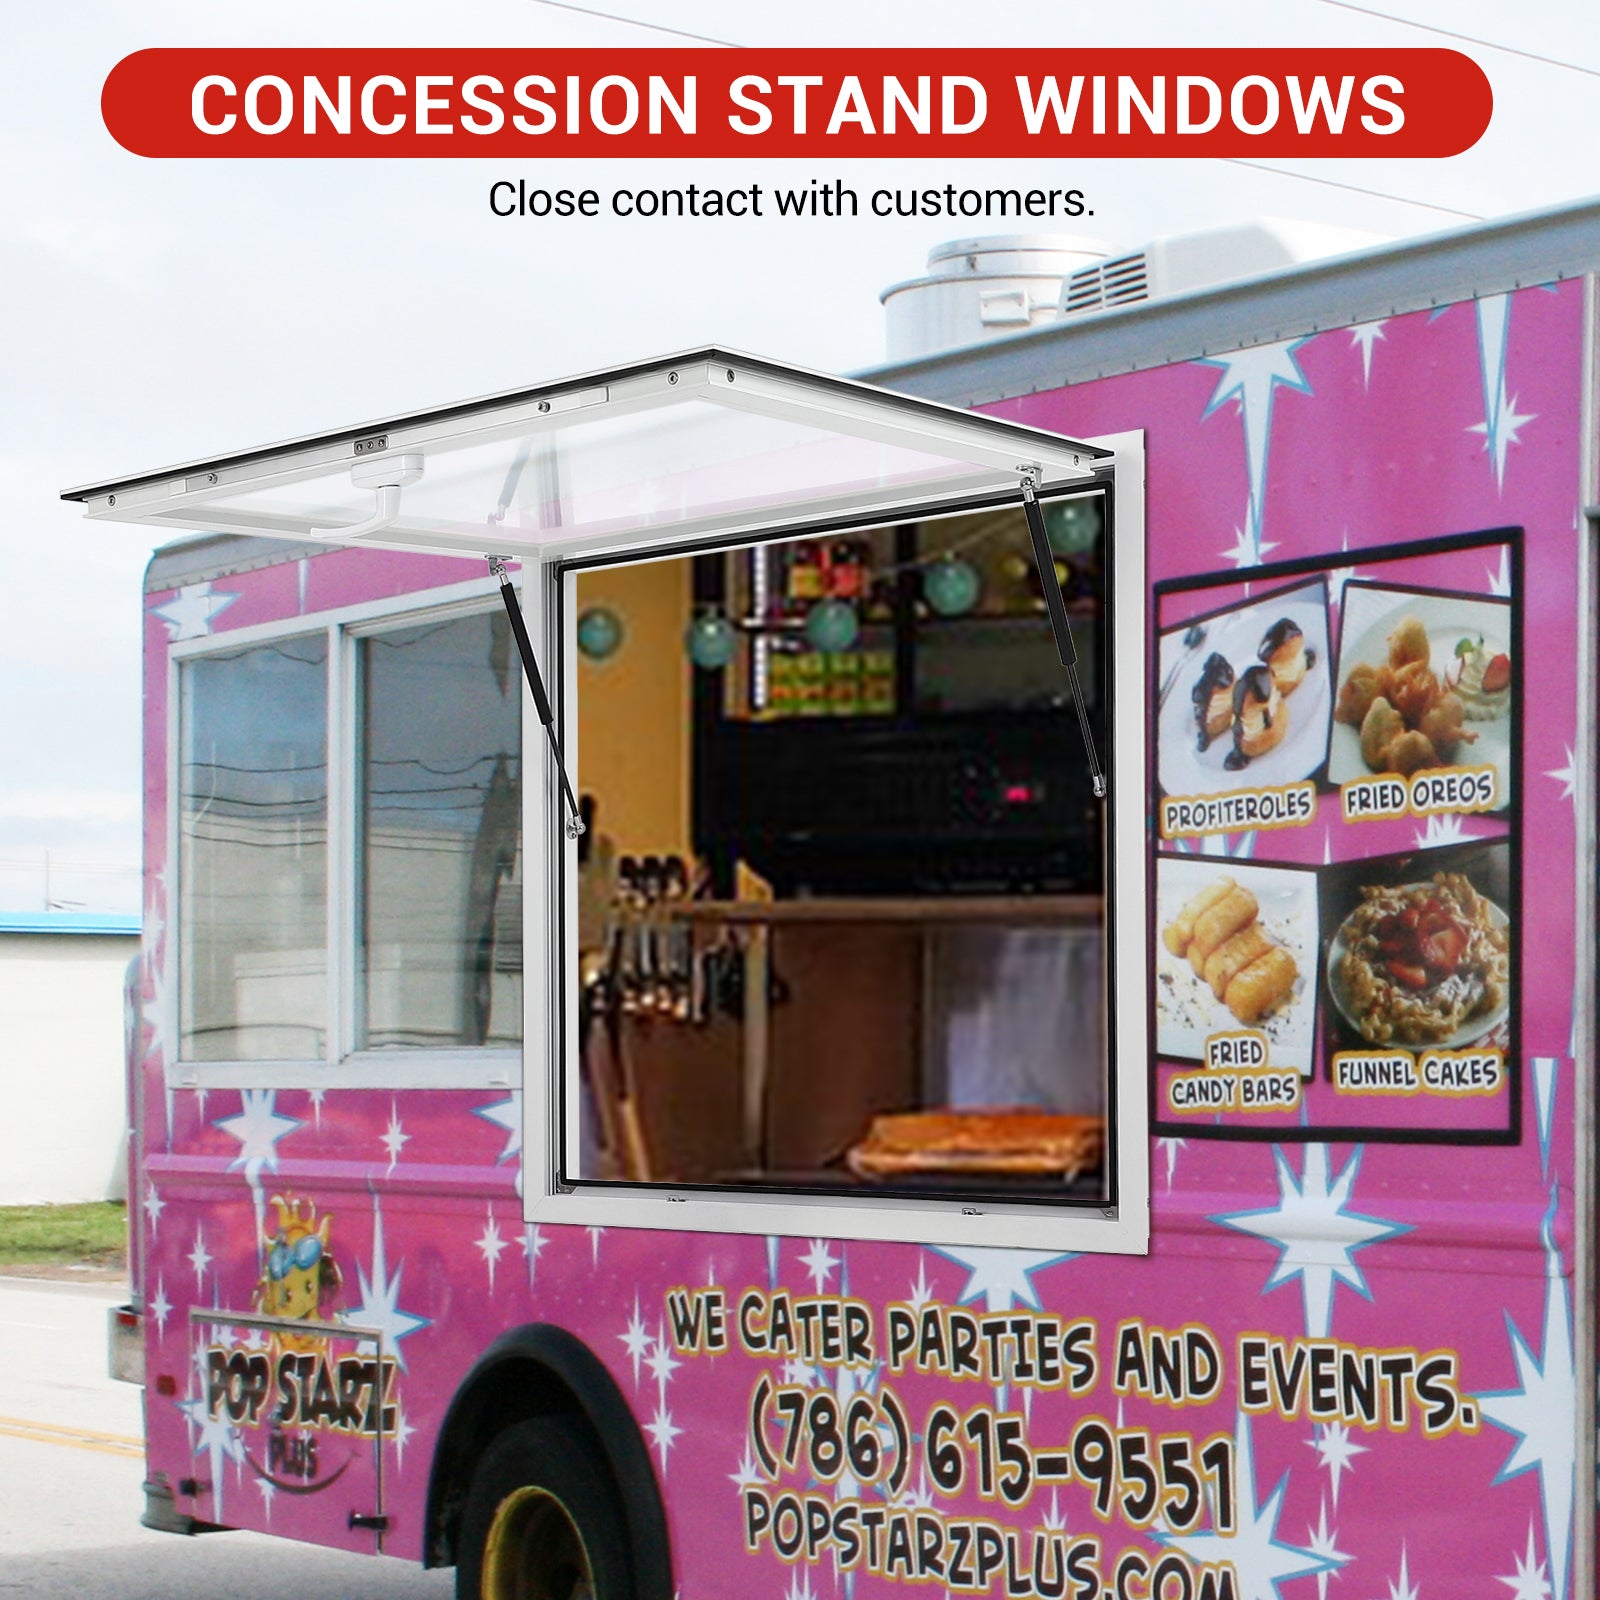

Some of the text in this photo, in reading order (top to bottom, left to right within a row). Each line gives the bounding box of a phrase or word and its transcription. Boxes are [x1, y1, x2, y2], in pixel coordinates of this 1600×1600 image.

[1166, 788, 1312, 830] PROFITEROLES
[1347, 773, 1493, 815] FRIED OREOS
[1210, 1040, 1263, 1065] FRIED
[1338, 1058, 1499, 1087] FUNNEL CAKES
[1171, 1076, 1297, 1105] CANDY BARS
[668, 1291, 1479, 1430] WE CATER PARTIES AND EVENTS.
[207, 1349, 398, 1434] POP STARZ
[268, 1433, 317, 1478] PLUS
[752, 1377, 1236, 1531] (786) 615-9551
[746, 1487, 1238, 1600] POPSTARZPLUS.COM
